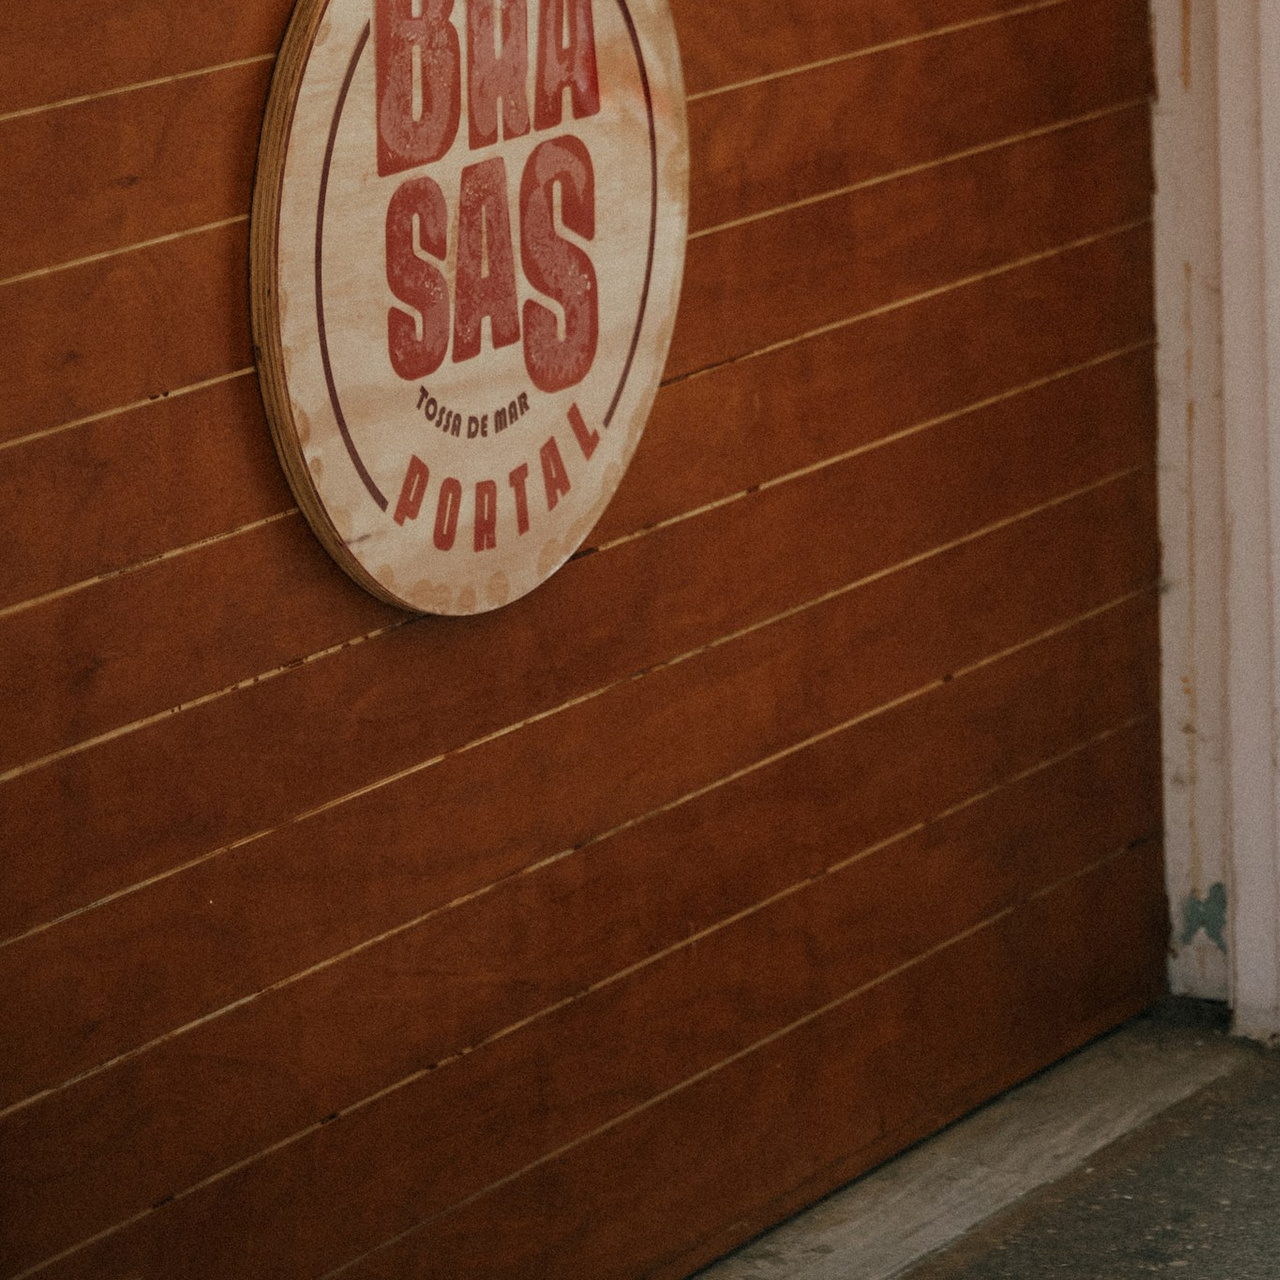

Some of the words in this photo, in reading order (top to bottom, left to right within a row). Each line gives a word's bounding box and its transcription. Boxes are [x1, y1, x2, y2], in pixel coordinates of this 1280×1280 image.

[385, 133, 600, 394] SAS
[393, 401, 604, 553] PORTAL
[416, 384, 463, 438] TOSSA
[467, 411, 489, 438] DE
[493, 391, 531, 435] MAR
